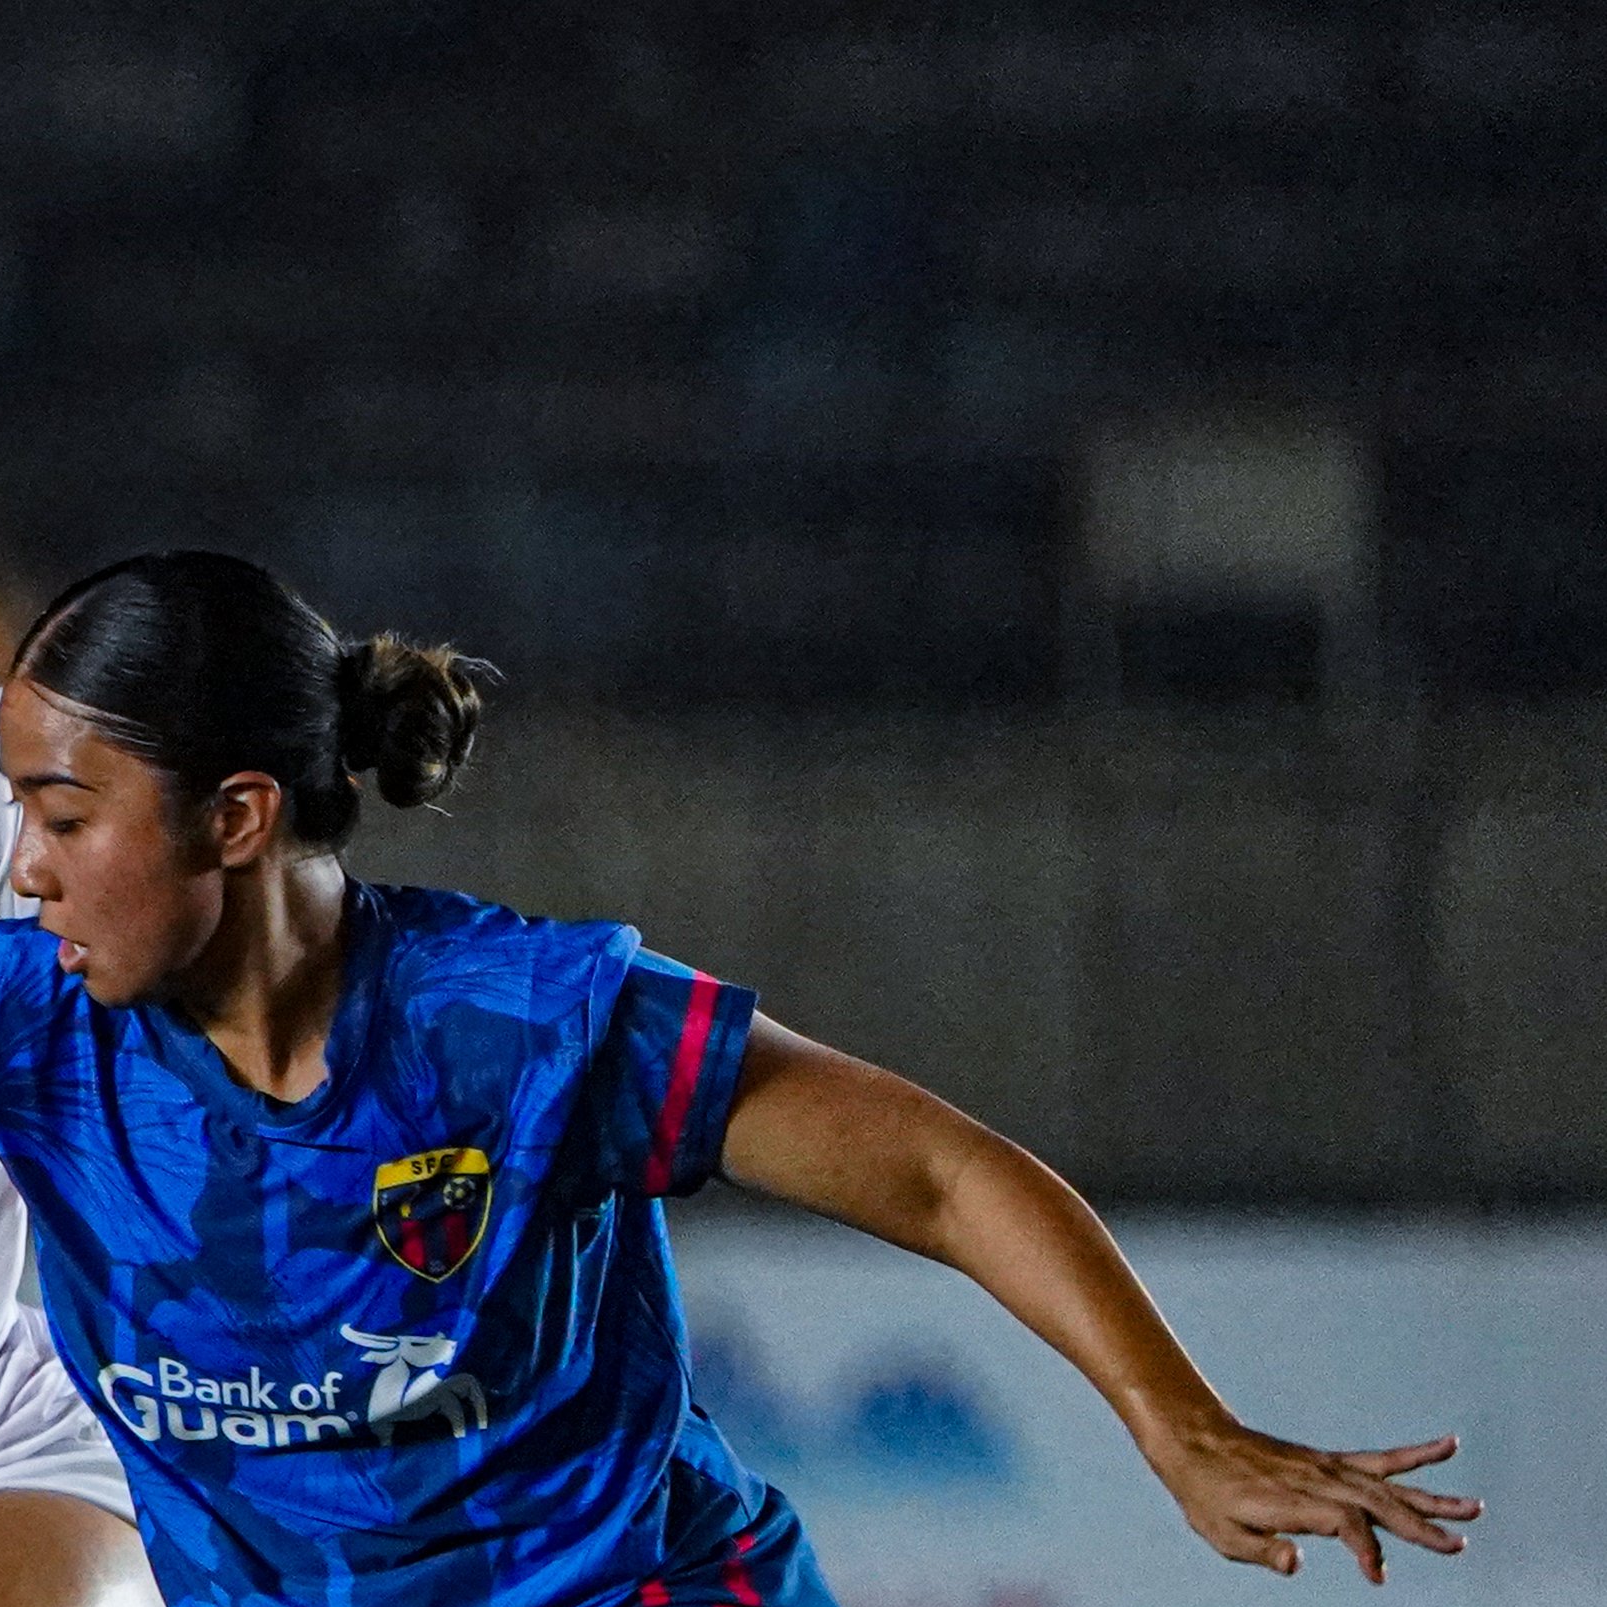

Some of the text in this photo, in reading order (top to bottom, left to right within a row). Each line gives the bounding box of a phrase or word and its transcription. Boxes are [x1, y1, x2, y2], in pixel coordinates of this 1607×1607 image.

[97, 1363, 353, 1447] Guam
[158, 1357, 343, 1411] Bank of
